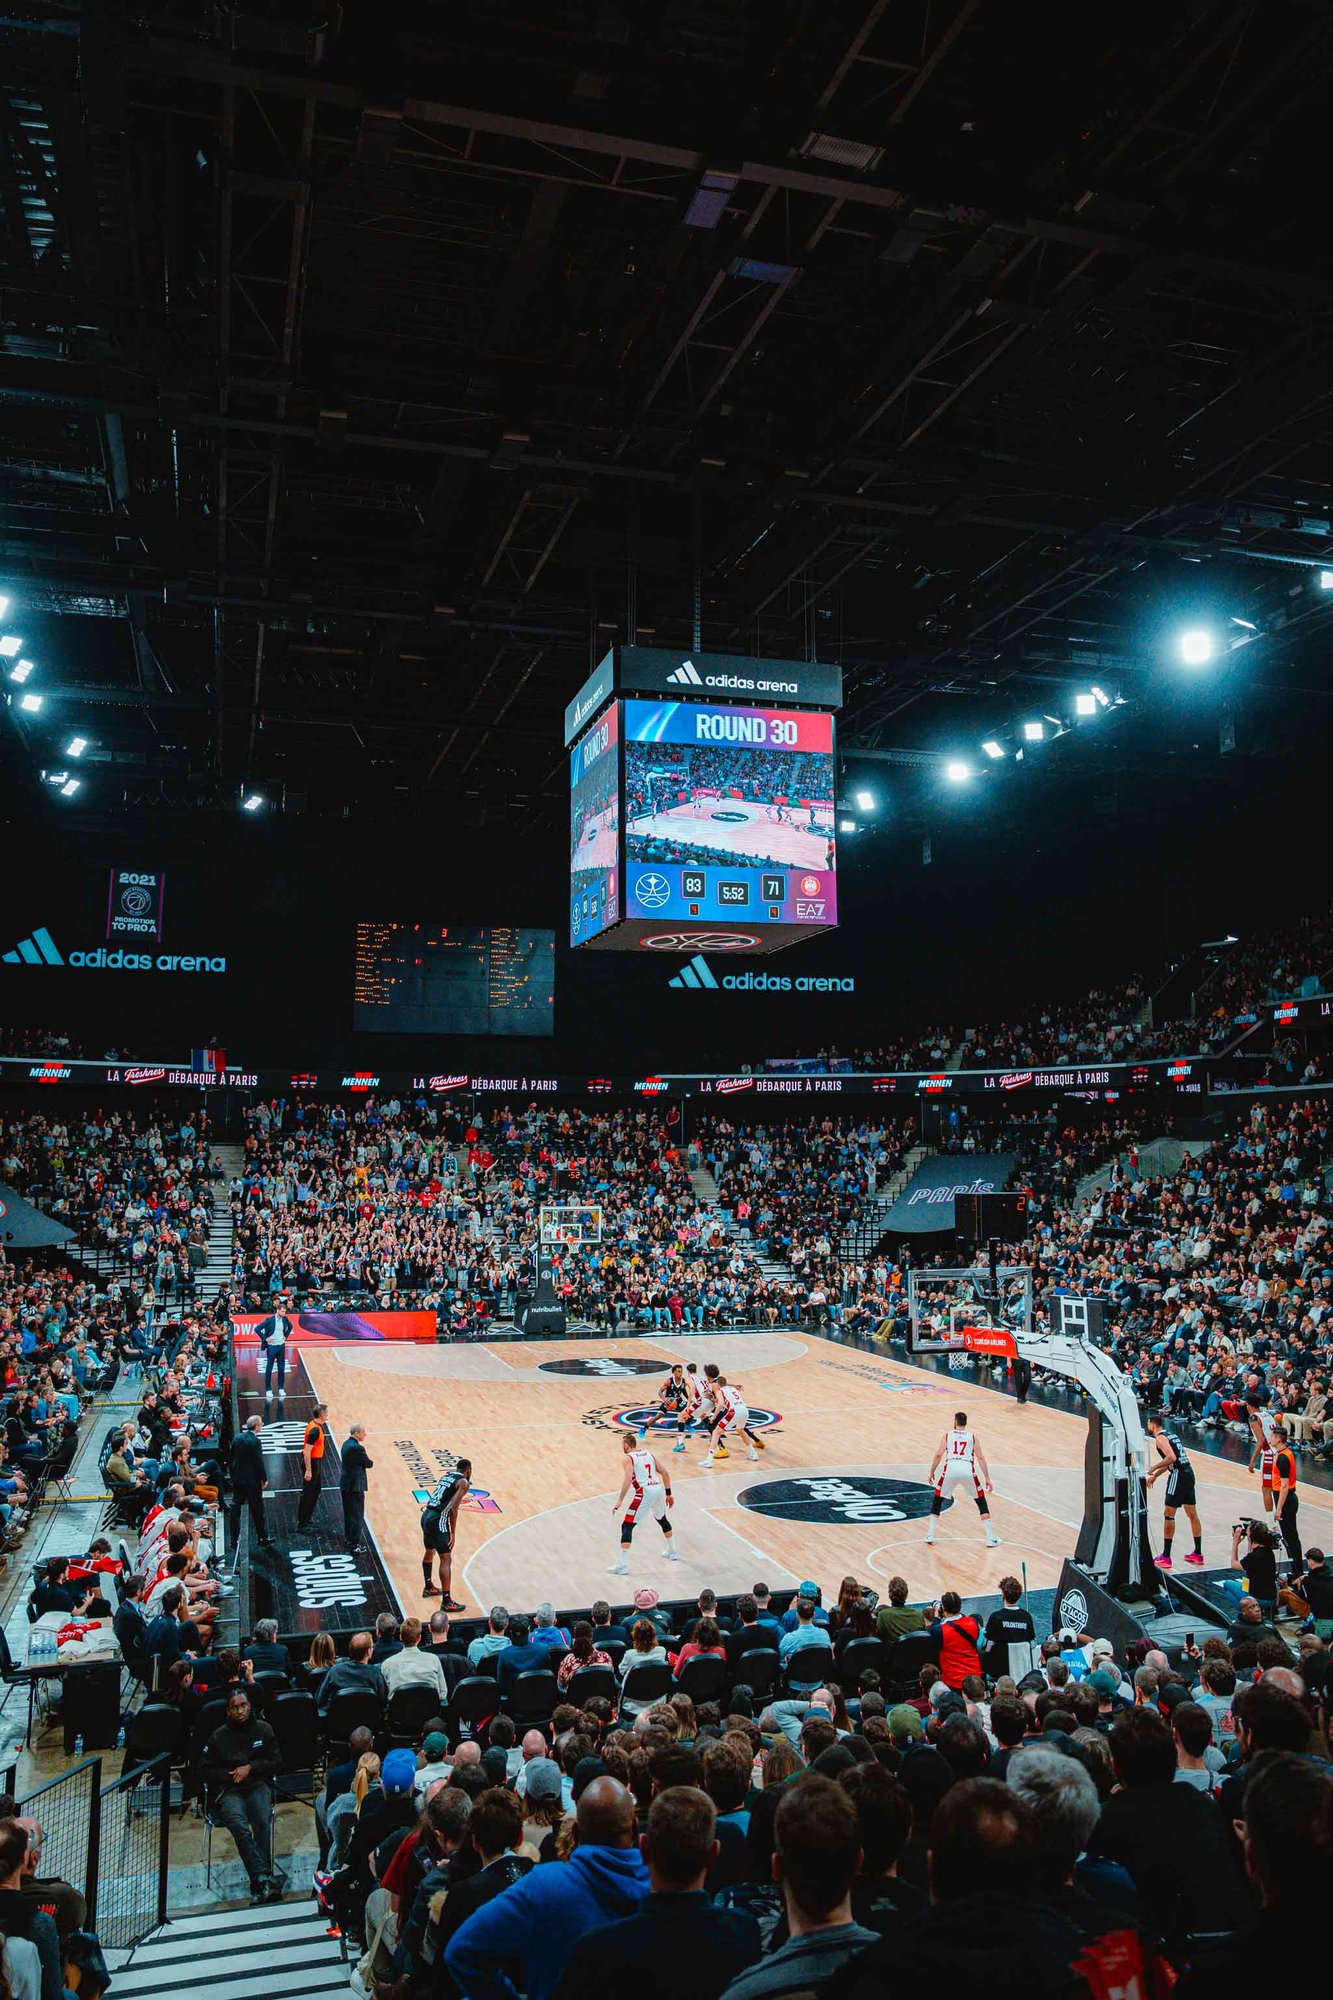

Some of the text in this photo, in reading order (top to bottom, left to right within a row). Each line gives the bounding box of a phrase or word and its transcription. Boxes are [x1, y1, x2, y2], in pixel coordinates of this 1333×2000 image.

[705, 674, 798, 693] adidas arena
[696, 713, 797, 745] ROUND 30
[119, 872, 156, 886] 2021
[686, 878, 701, 892] 83
[723, 886, 744, 900] 5:52
[767, 881, 779, 895] 71
[796, 903, 825, 916] EA7
[112, 922, 157, 933] TO PRO A
[114, 916, 155, 925] PROMOTION
[69, 948, 226, 972] adidas arena
[722, 972, 854, 992] adidas arena
[1274, 1007, 1298, 1019] MENNEN
[1321, 1002, 1330, 1015] LA
[29, 1068, 71, 1079] MENNEN
[107, 1067, 258, 1086] LA Freshness DÉBARQUE À PARIS
[1167, 1065, 1192, 1077] MENNEN
[341, 1077, 380, 1087] MENNEN
[413, 1074, 558, 1091] LA Freshness DÉBARQUE À PARIS
[634, 1081, 669, 1091] MENNEN
[700, 1077, 842, 1092] LA Freshness DÉBARQUE À PARIS
[918, 1078, 952, 1088] MENNEN
[984, 1070, 1109, 1088] LA Freshness DÉBARQUE À PARIS
[953, 1440, 967, 1456] 17
[644, 1463, 652, 1479] 7
[1061, 1601, 1088, 1625] O'TACOS
